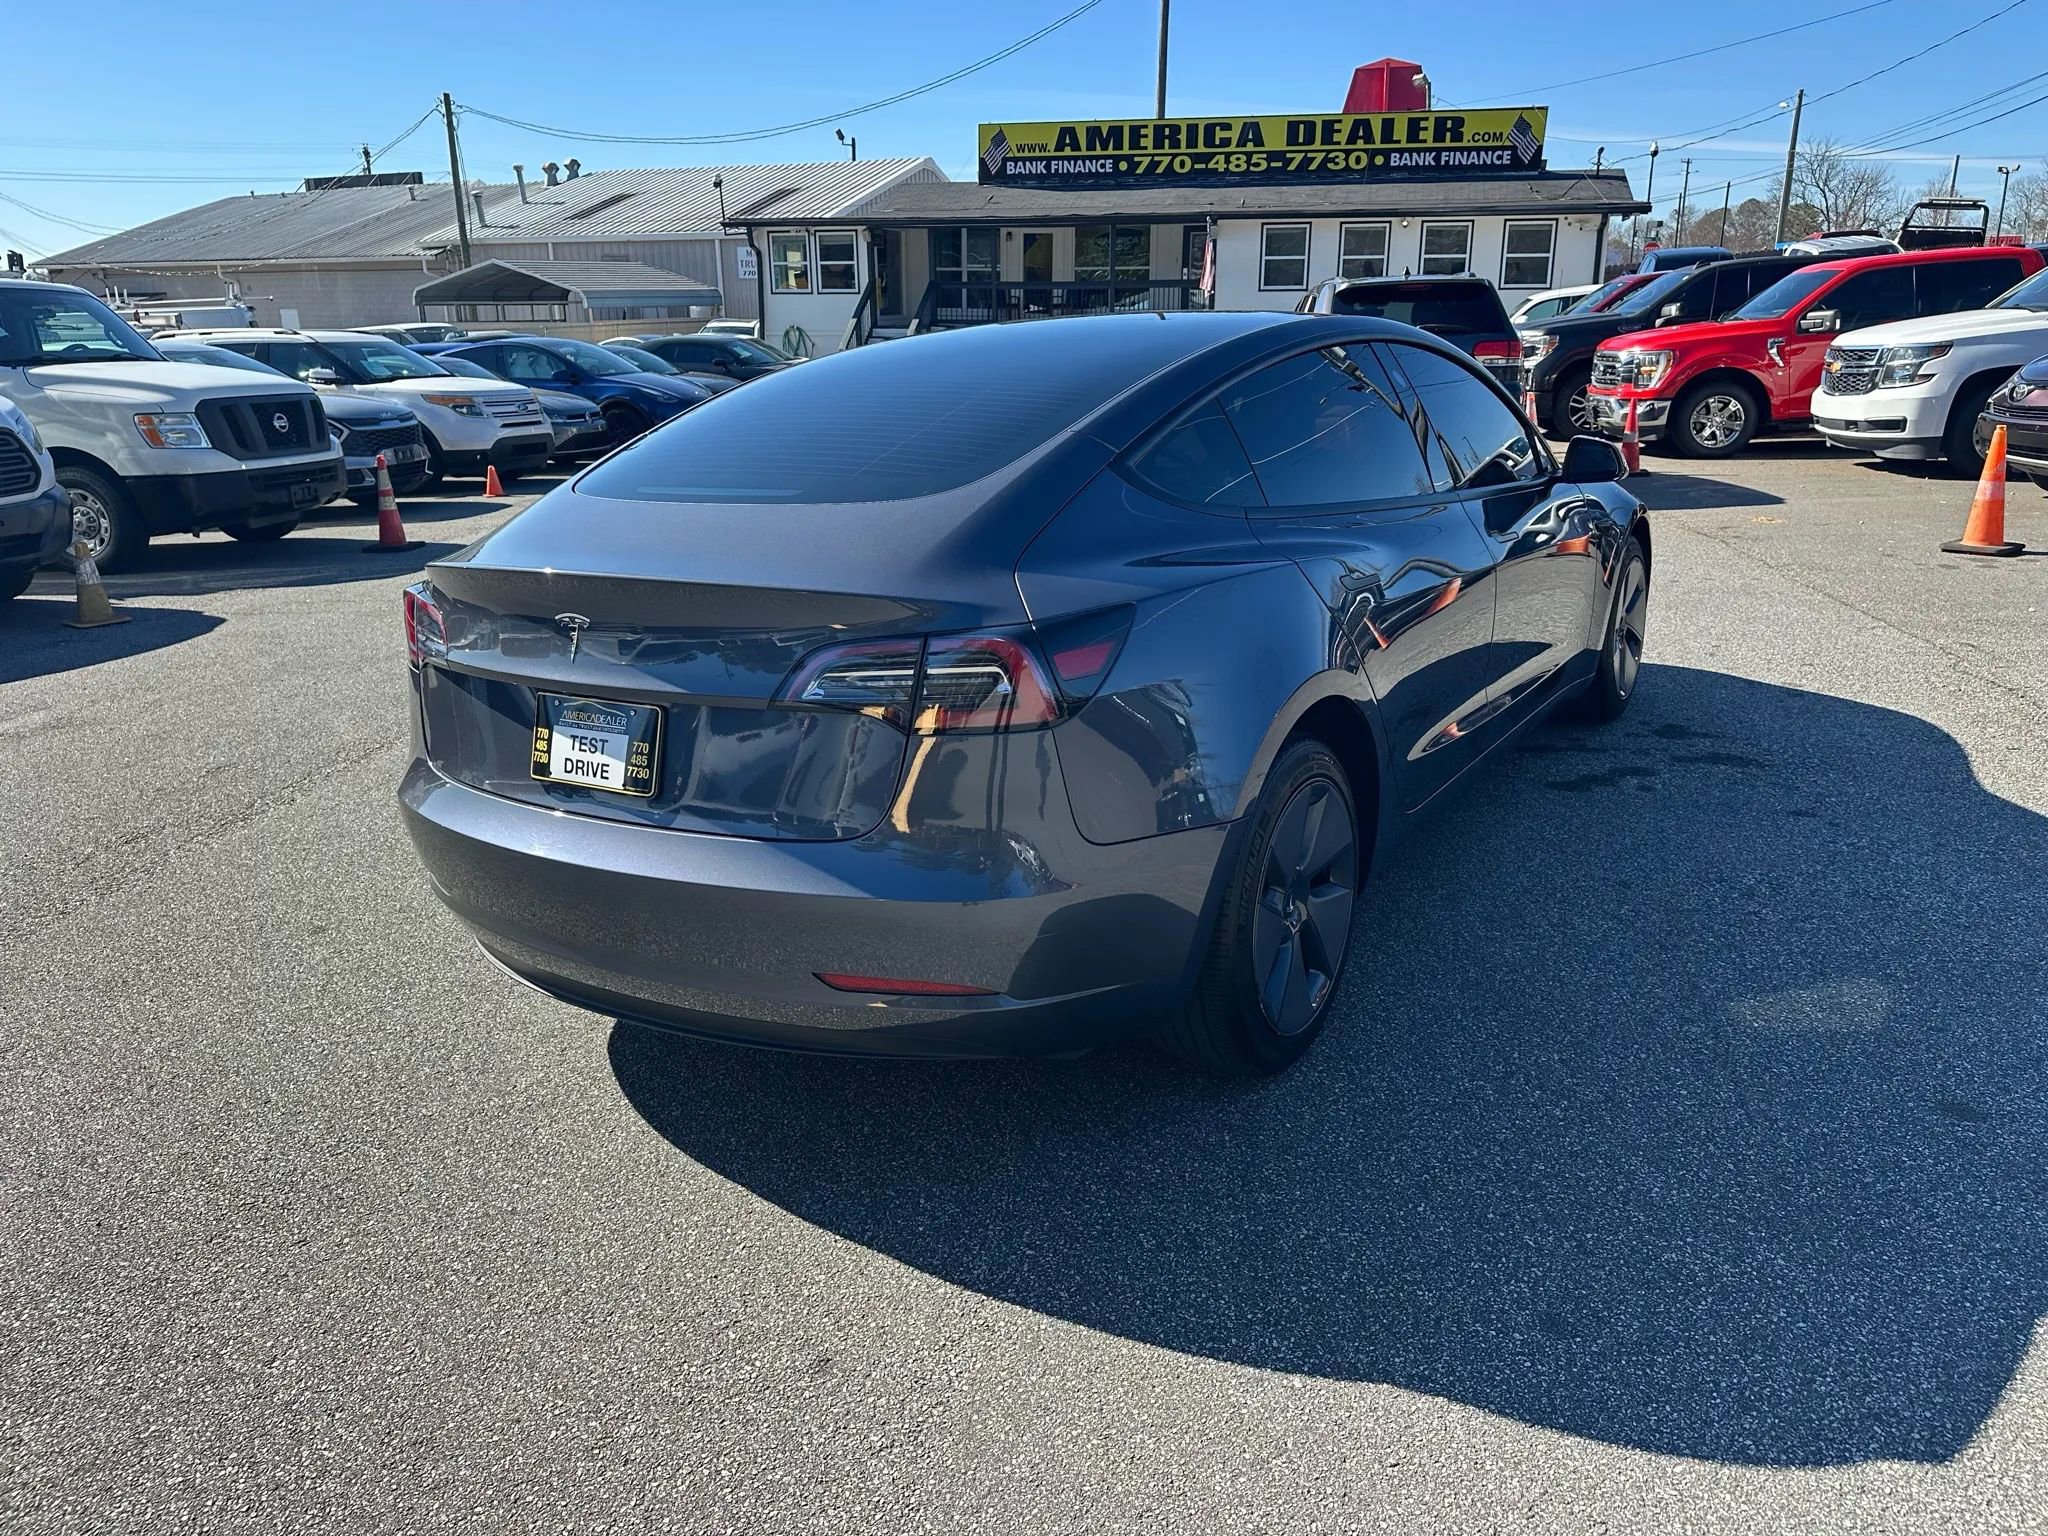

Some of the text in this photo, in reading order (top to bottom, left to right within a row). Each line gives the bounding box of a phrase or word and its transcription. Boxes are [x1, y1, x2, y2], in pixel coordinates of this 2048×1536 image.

[1053, 121, 1265, 152] AMERICA
[1286, 116, 1465, 147] DEALER
[1006, 150, 1511, 175] BANK FINANCE 770-485-7730 BANK FINANCE
[536, 727, 549, 739] 770
[535, 740, 548, 751] 485
[570, 734, 608, 756] TEST
[632, 741, 649, 753] 770
[533, 752, 549, 764] 7730
[630, 754, 648, 766] 485
[564, 757, 610, 780] DRIVE
[626, 766, 650, 779] 7730
